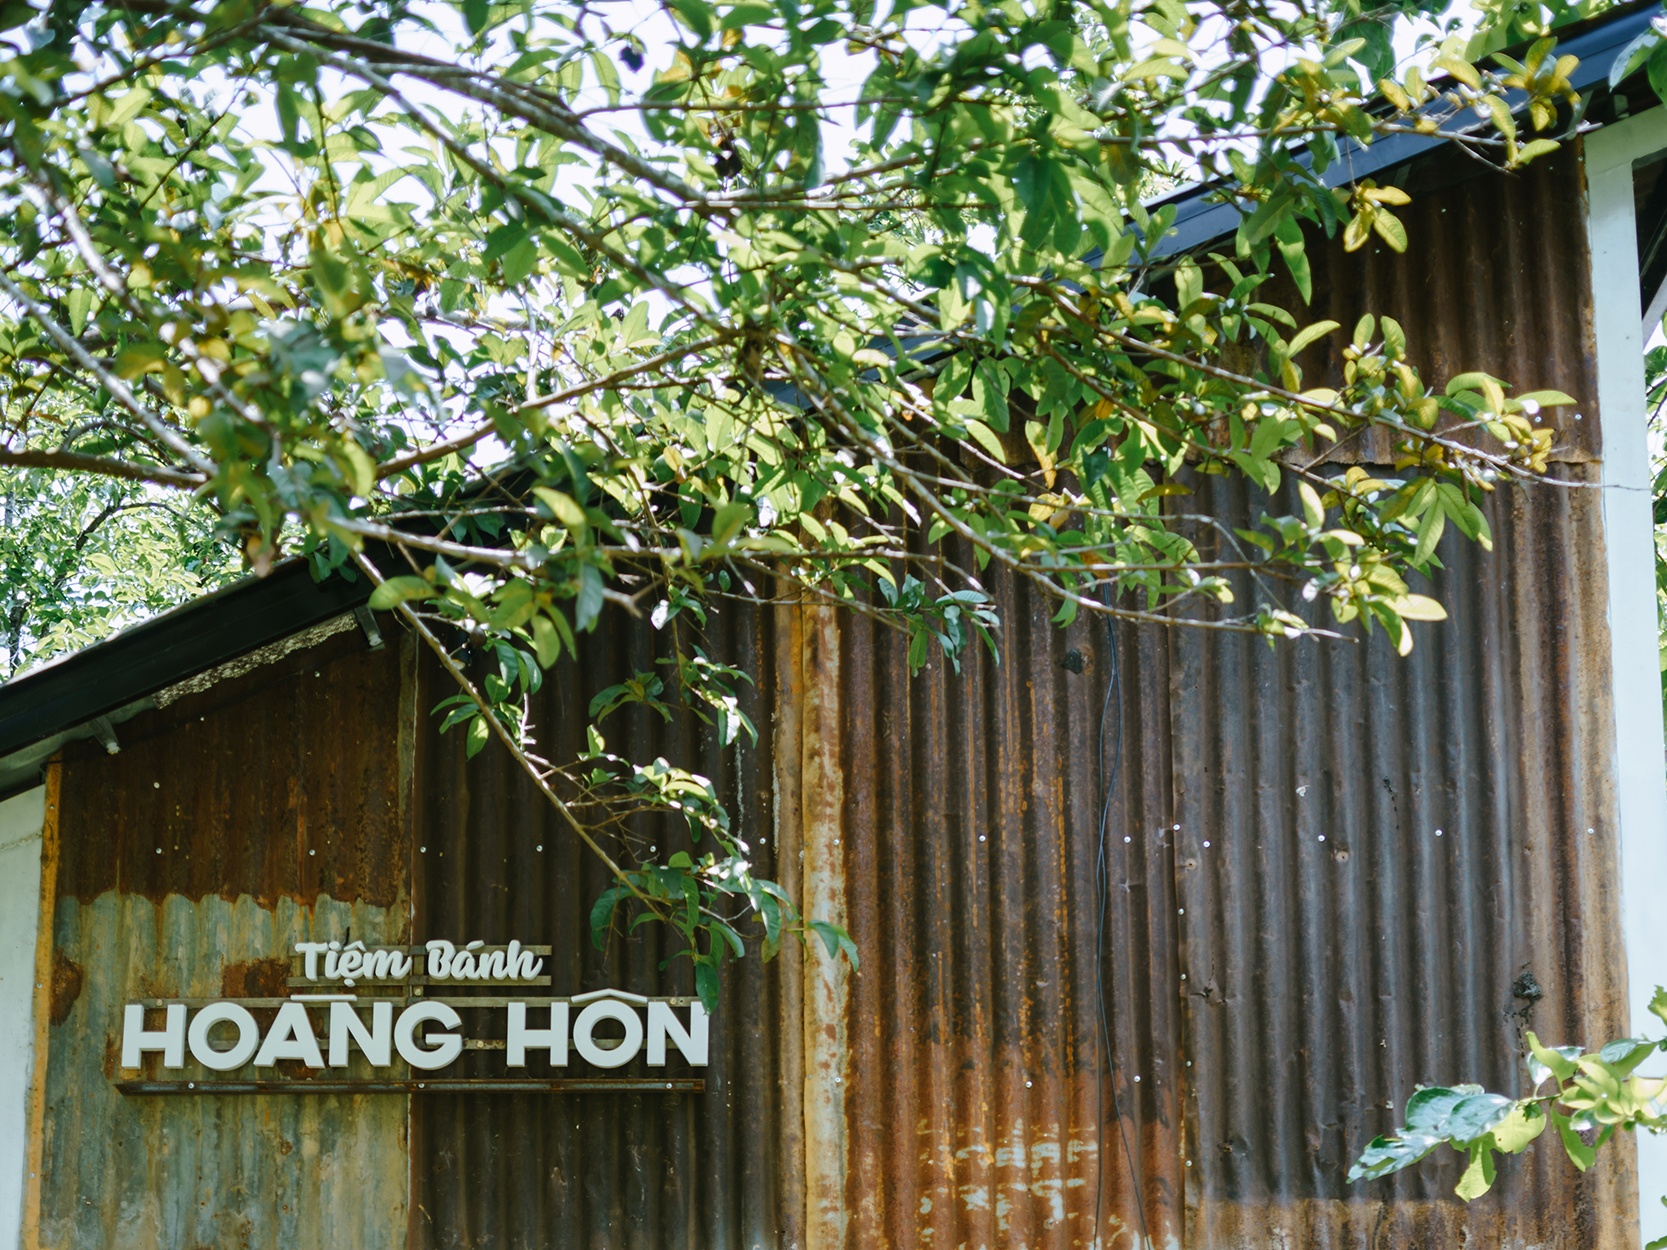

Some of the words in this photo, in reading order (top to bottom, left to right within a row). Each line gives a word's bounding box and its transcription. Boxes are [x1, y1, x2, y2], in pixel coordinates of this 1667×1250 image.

[294, 939, 411, 987] Tiệm
[425, 939, 544, 981] Bánh
[506, 988, 709, 1068] HÔN
